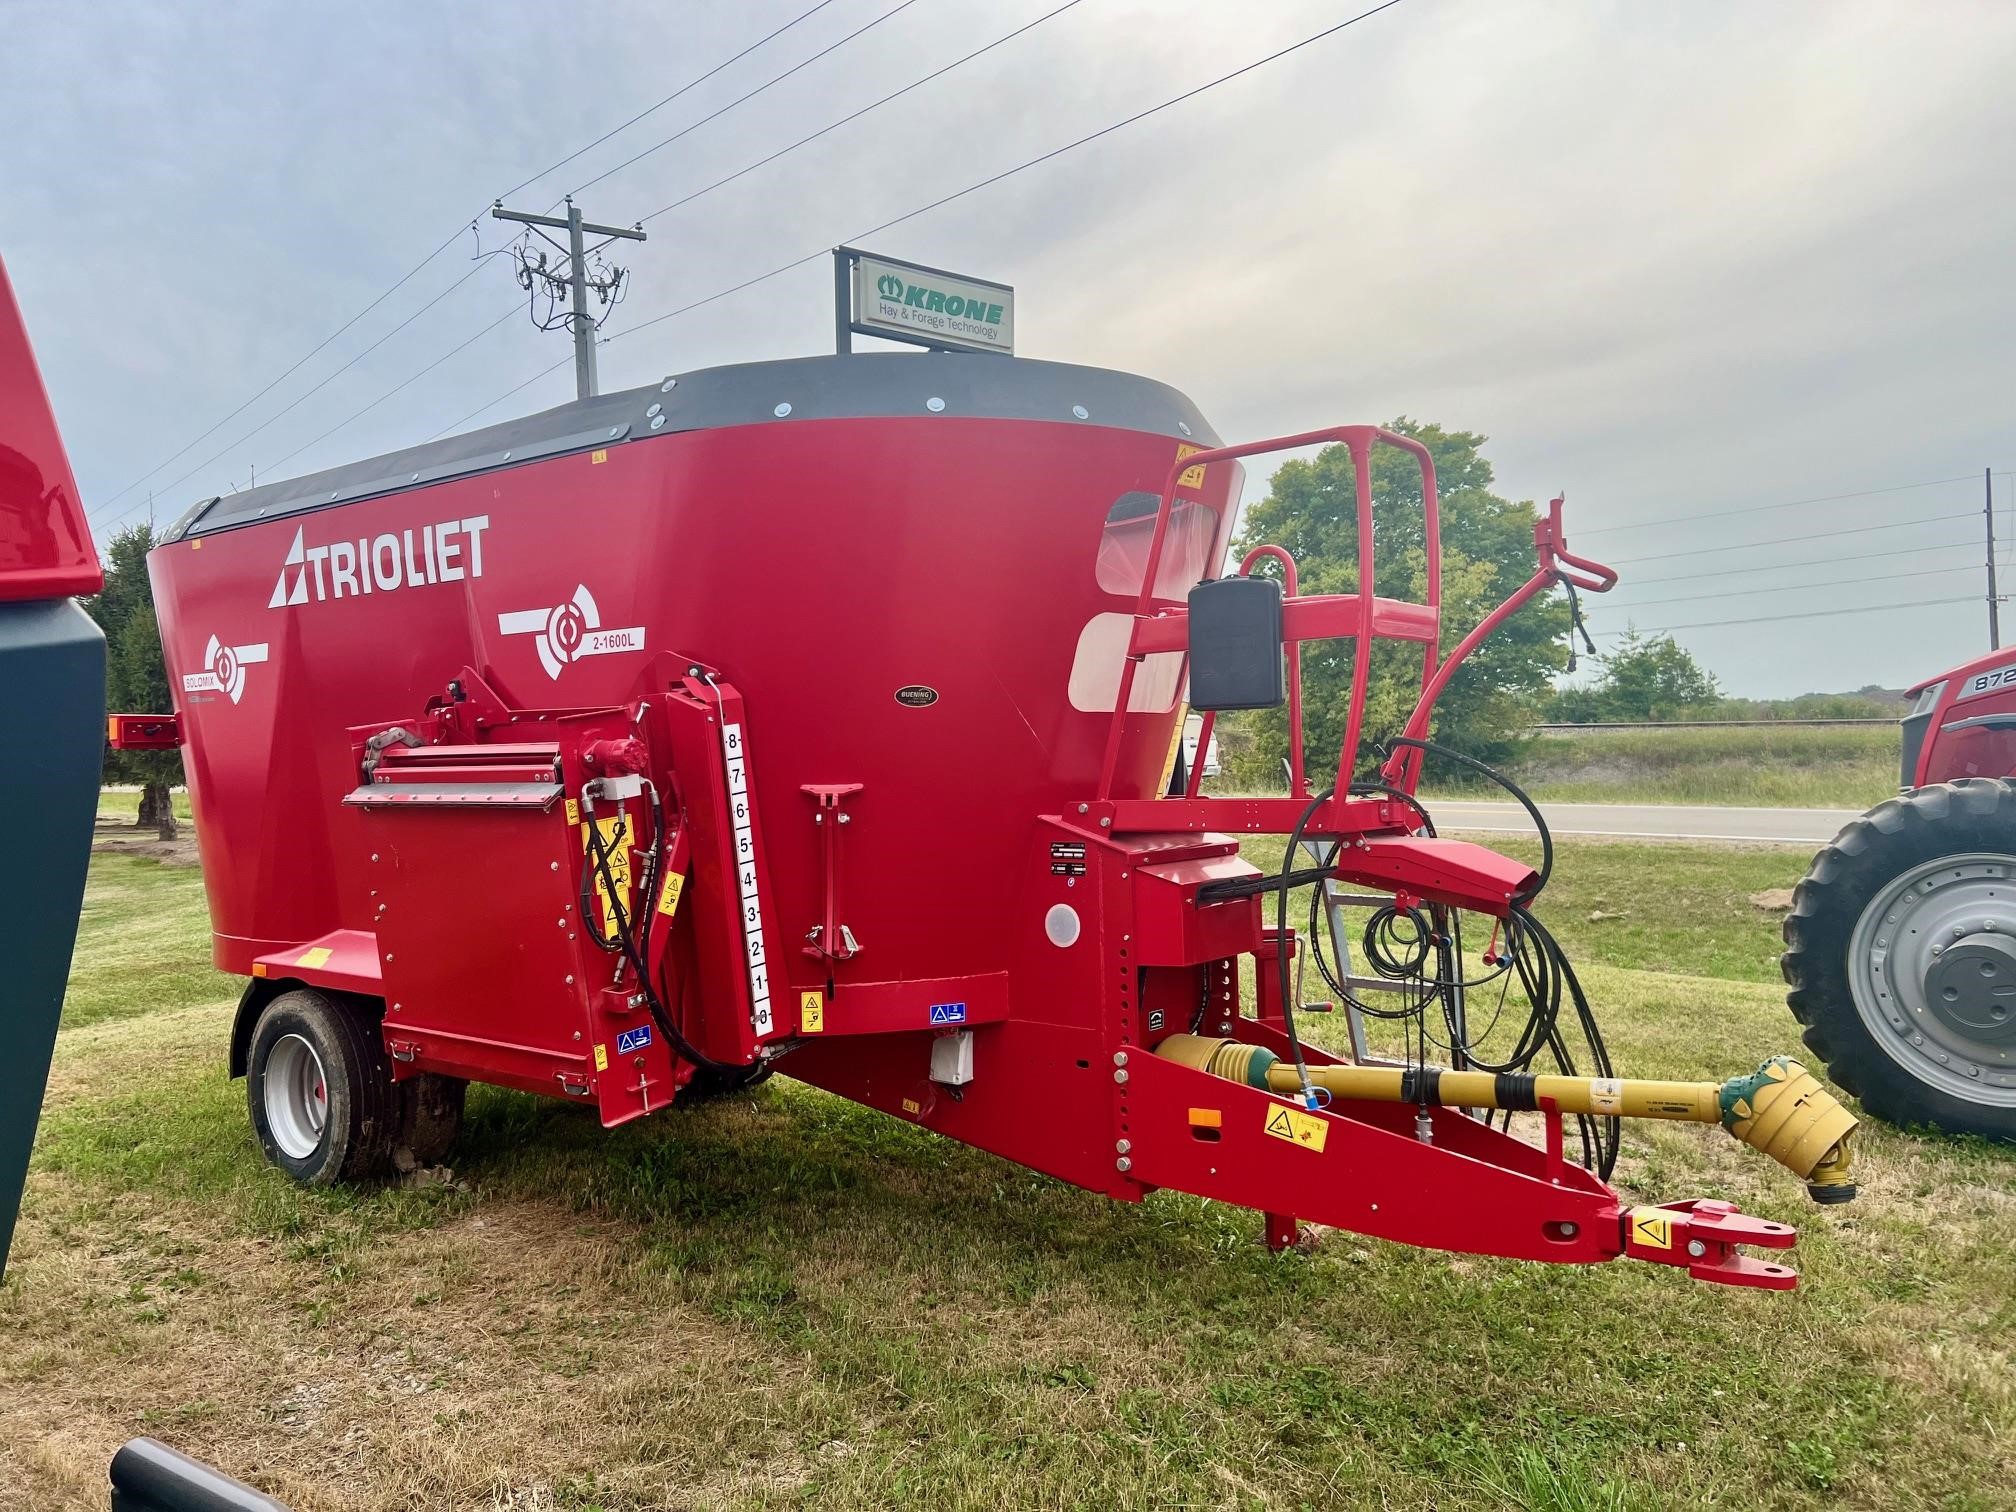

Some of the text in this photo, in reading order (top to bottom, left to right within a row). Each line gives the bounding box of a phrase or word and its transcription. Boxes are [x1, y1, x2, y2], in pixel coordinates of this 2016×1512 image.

[904, 285, 1004, 325] KRONE
[879, 302, 998, 340] Hay & Forage Technology
[306, 514, 490, 601] TRIOLIET
[593, 633, 635, 650] 2-1600L
[186, 676, 215, 689] SOLOMIX
[728, 733, 737, 748] 8
[732, 768, 740, 783] 7
[736, 803, 745, 818] 6
[740, 838, 749, 853] 5
[744, 872, 753, 887] 4
[748, 906, 756, 922] 3
[751, 941, 760, 957] 2
[755, 975, 763, 990] 1
